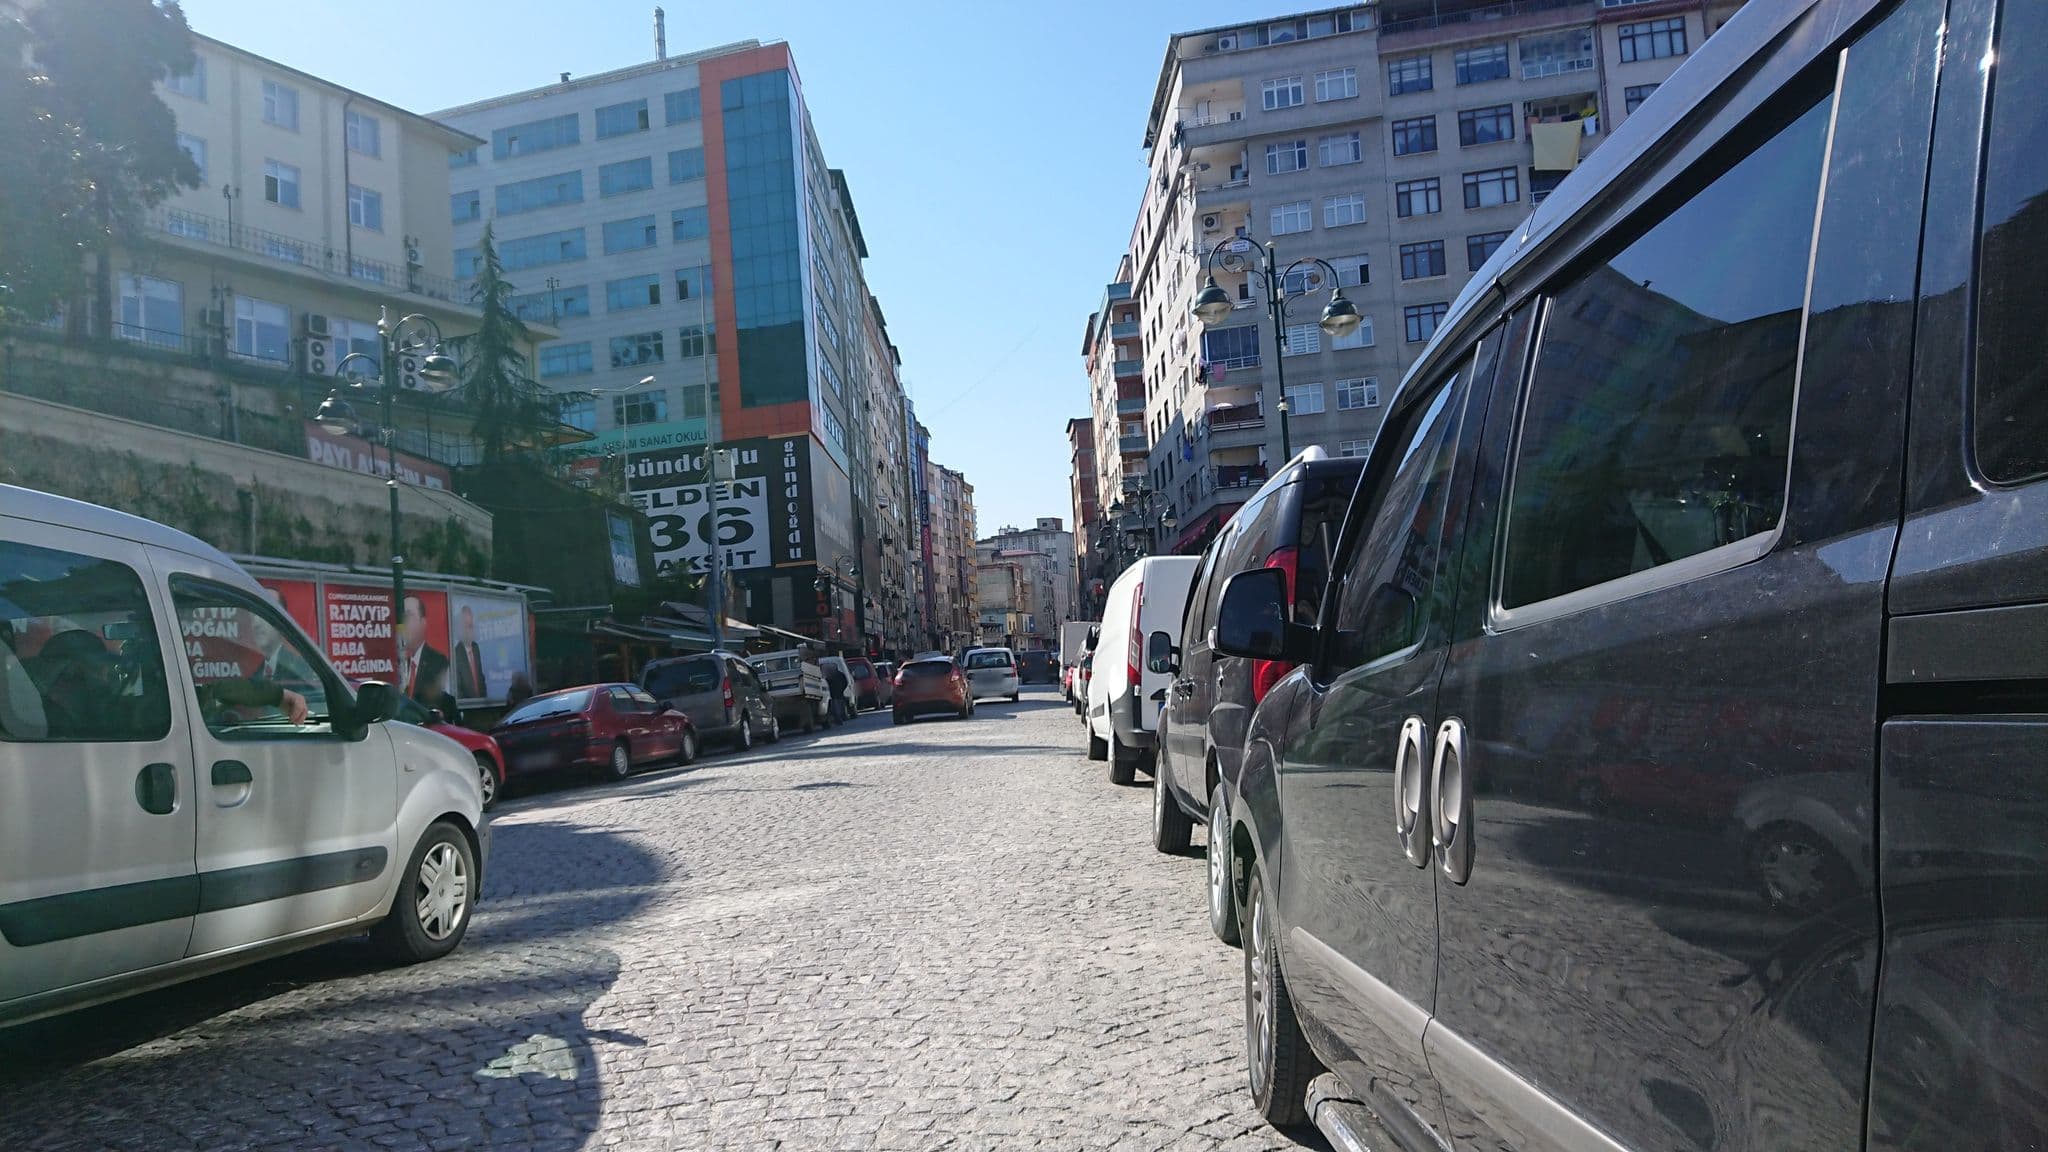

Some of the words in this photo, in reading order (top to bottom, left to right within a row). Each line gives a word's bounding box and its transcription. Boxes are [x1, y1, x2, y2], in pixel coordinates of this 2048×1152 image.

[640, 432, 672, 448] SANAT
[648, 507, 754, 552] 36
[330, 620, 392, 638] ERDOĞAN
[332, 642, 366, 656] BABA
[334, 656, 393, 674] OCAĞINDA
